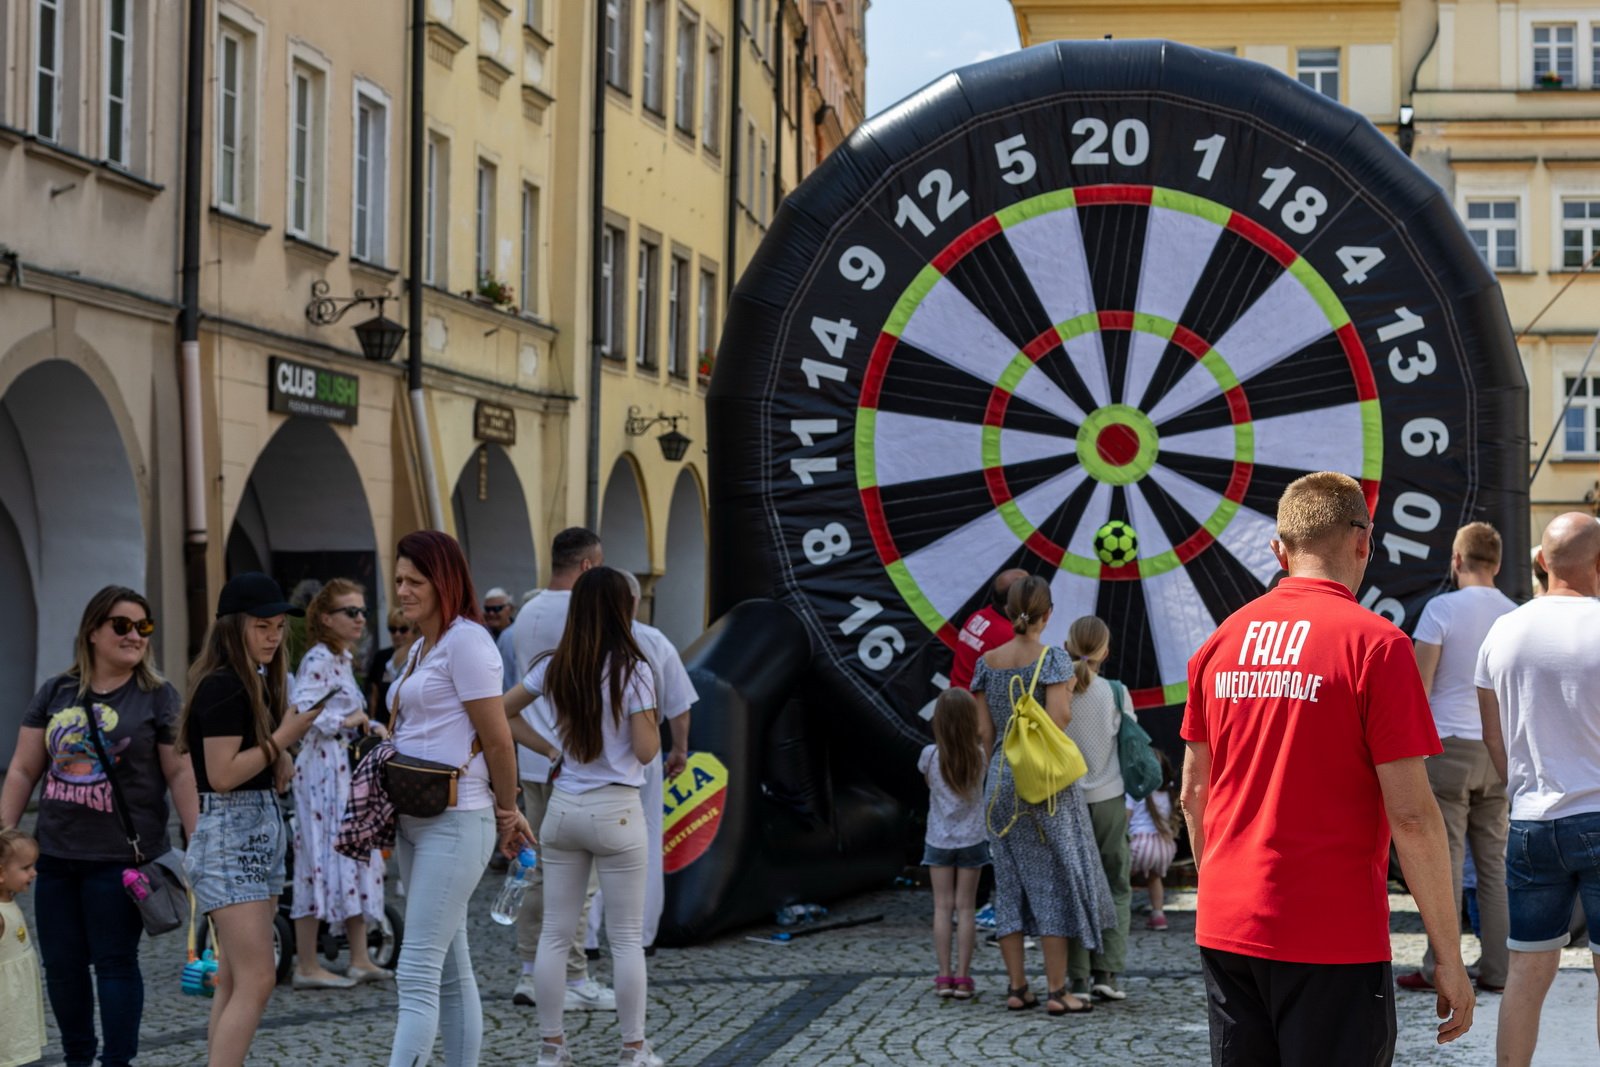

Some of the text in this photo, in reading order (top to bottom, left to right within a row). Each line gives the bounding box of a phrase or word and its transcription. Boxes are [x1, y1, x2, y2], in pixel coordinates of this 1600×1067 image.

[994, 133, 1037, 185] 5
[1071, 117, 1150, 166] 20
[1193, 133, 1226, 181] 1
[894, 168, 970, 237] 12
[1258, 166, 1328, 235] 18
[838, 245, 886, 291] 9
[1335, 245, 1386, 285] 4
[800, 316, 858, 389] 14
[1376, 306, 1437, 384] 13
[277, 363, 316, 398] CLUB
[790, 419, 838, 485] 11
[1401, 417, 1450, 457] 6
[802, 522, 852, 565] 8
[1382, 491, 1442, 565] 10
[838, 596, 906, 671] 16
[1238, 619, 1312, 666] FALA
[1215, 670, 1324, 704] MIĘDZYZDROJE
